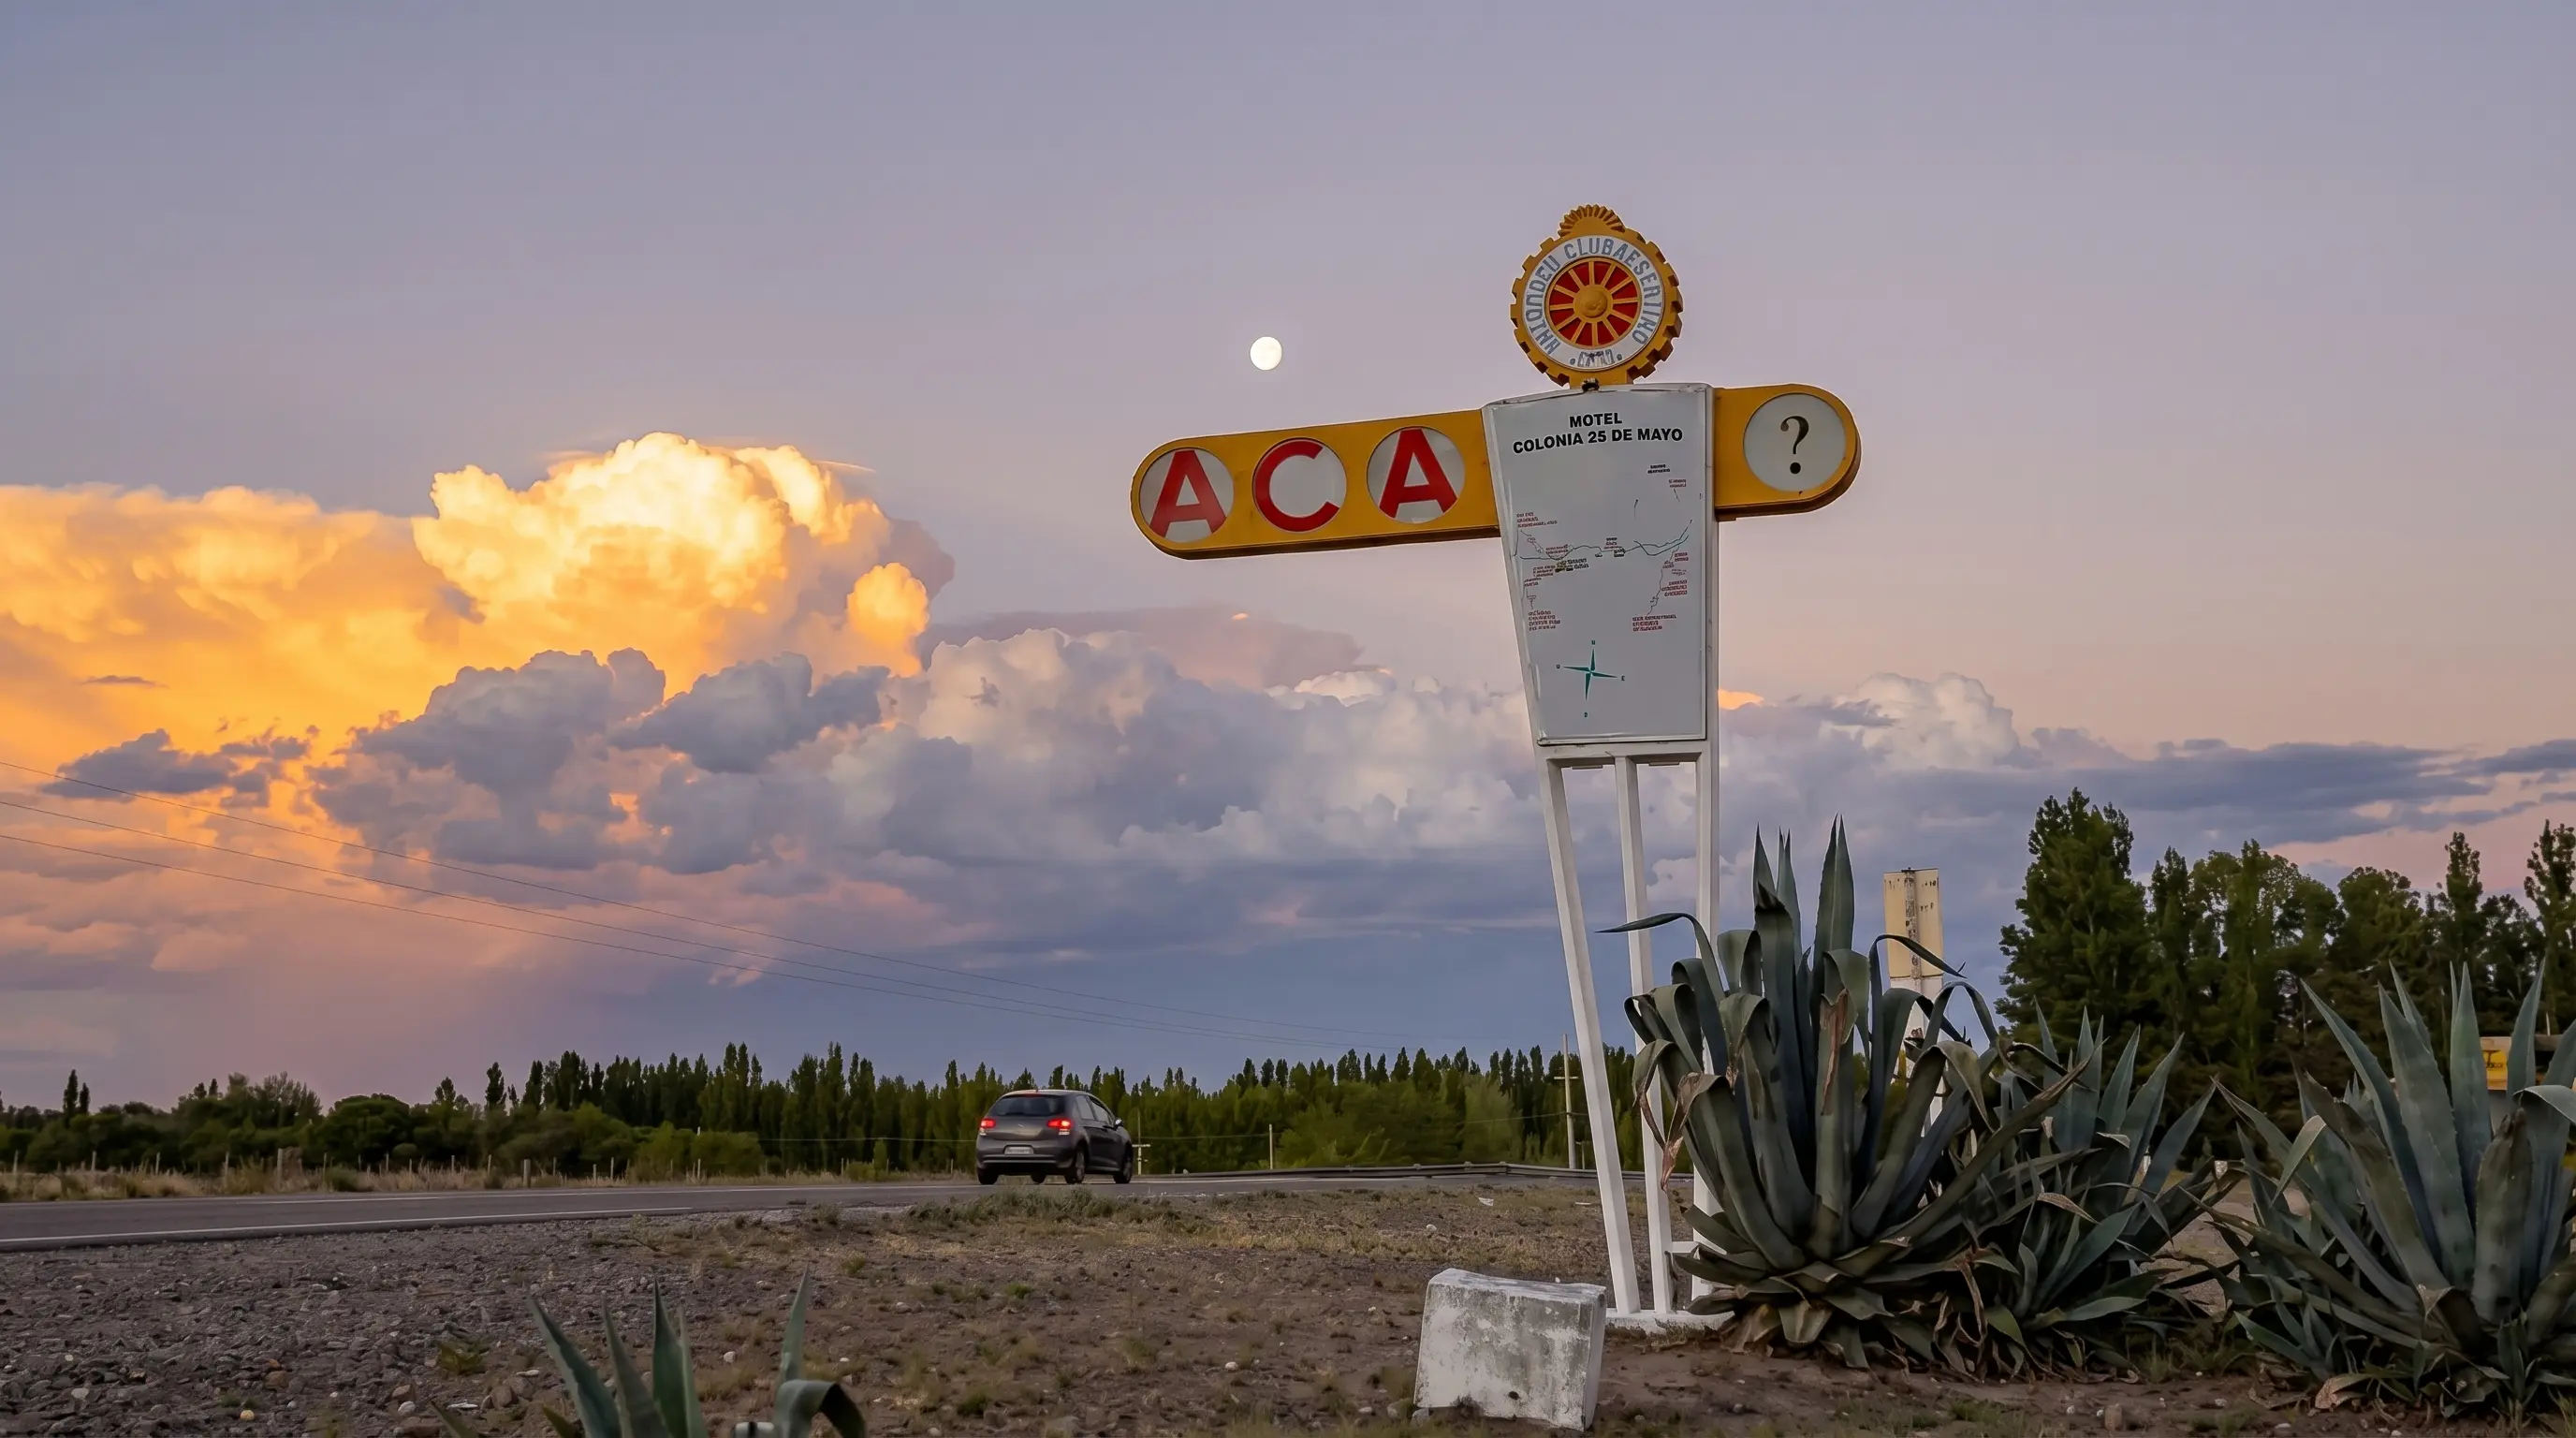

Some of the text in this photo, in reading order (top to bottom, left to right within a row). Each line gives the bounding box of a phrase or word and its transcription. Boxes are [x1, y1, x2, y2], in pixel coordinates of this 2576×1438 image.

[1569, 412, 1623, 429] MOTEL
[1513, 427, 1684, 454] COLONIA 25 DE MAYO
[1779, 415, 1810, 475] ?
